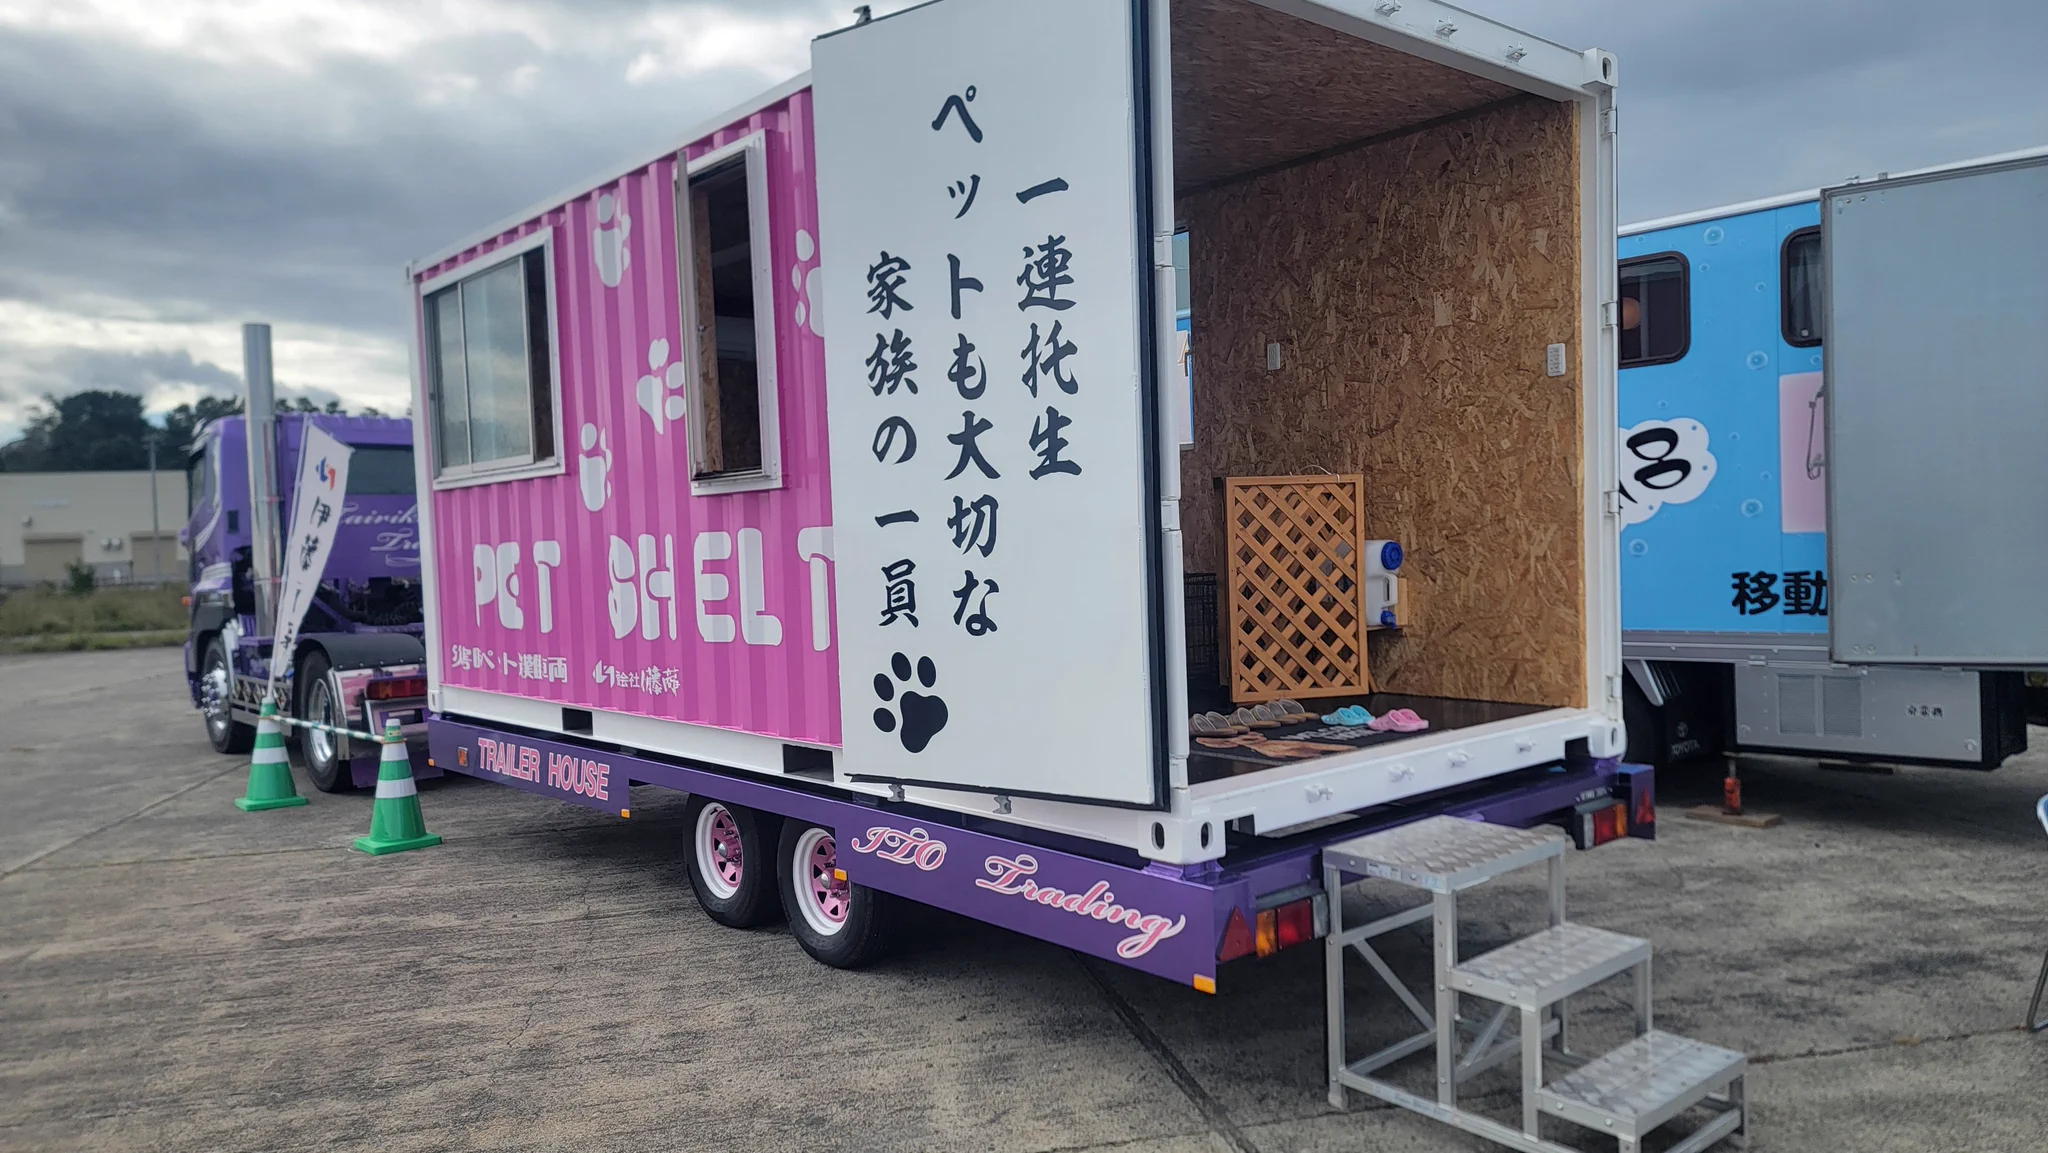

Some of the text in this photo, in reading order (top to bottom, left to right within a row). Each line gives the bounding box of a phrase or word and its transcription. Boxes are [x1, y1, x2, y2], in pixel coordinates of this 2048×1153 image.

[931, 84, 1001, 638] ペットも大切な
[1015, 176, 1083, 481] 一連托生
[865, 250, 920, 628] 家族の一員
[1619, 427, 1691, 505] 呂
[473, 541, 561, 634] PET
[1732, 570, 1827, 616] 移動
[478, 737, 610, 801] TRAILER HOUSE
[851, 827, 1187, 959] ITO Trading
